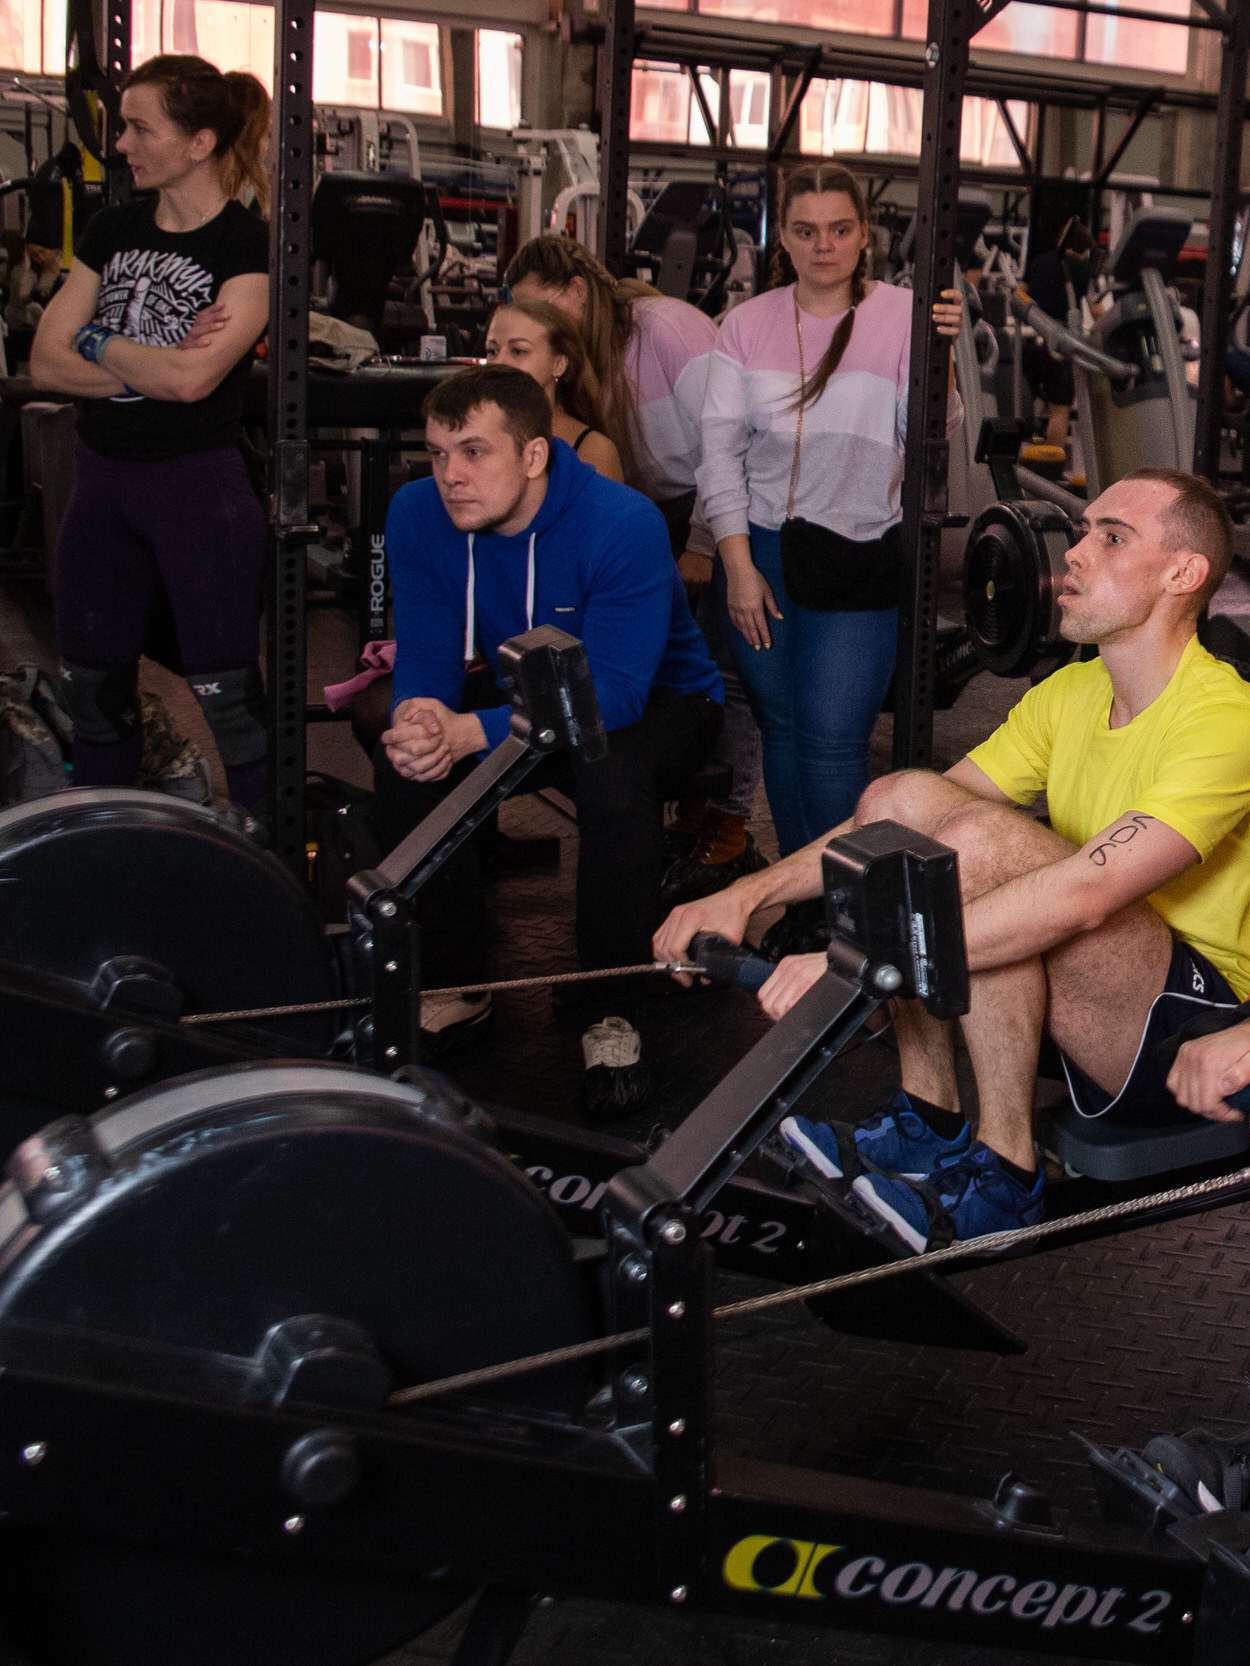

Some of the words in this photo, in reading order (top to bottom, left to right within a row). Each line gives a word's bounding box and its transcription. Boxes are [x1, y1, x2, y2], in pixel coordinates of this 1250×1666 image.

[370, 533, 385, 612] ROGUE
[751, 1221, 787, 1254] 2
[835, 1555, 1126, 1627] concept
[1128, 1589, 1173, 1632] 2
